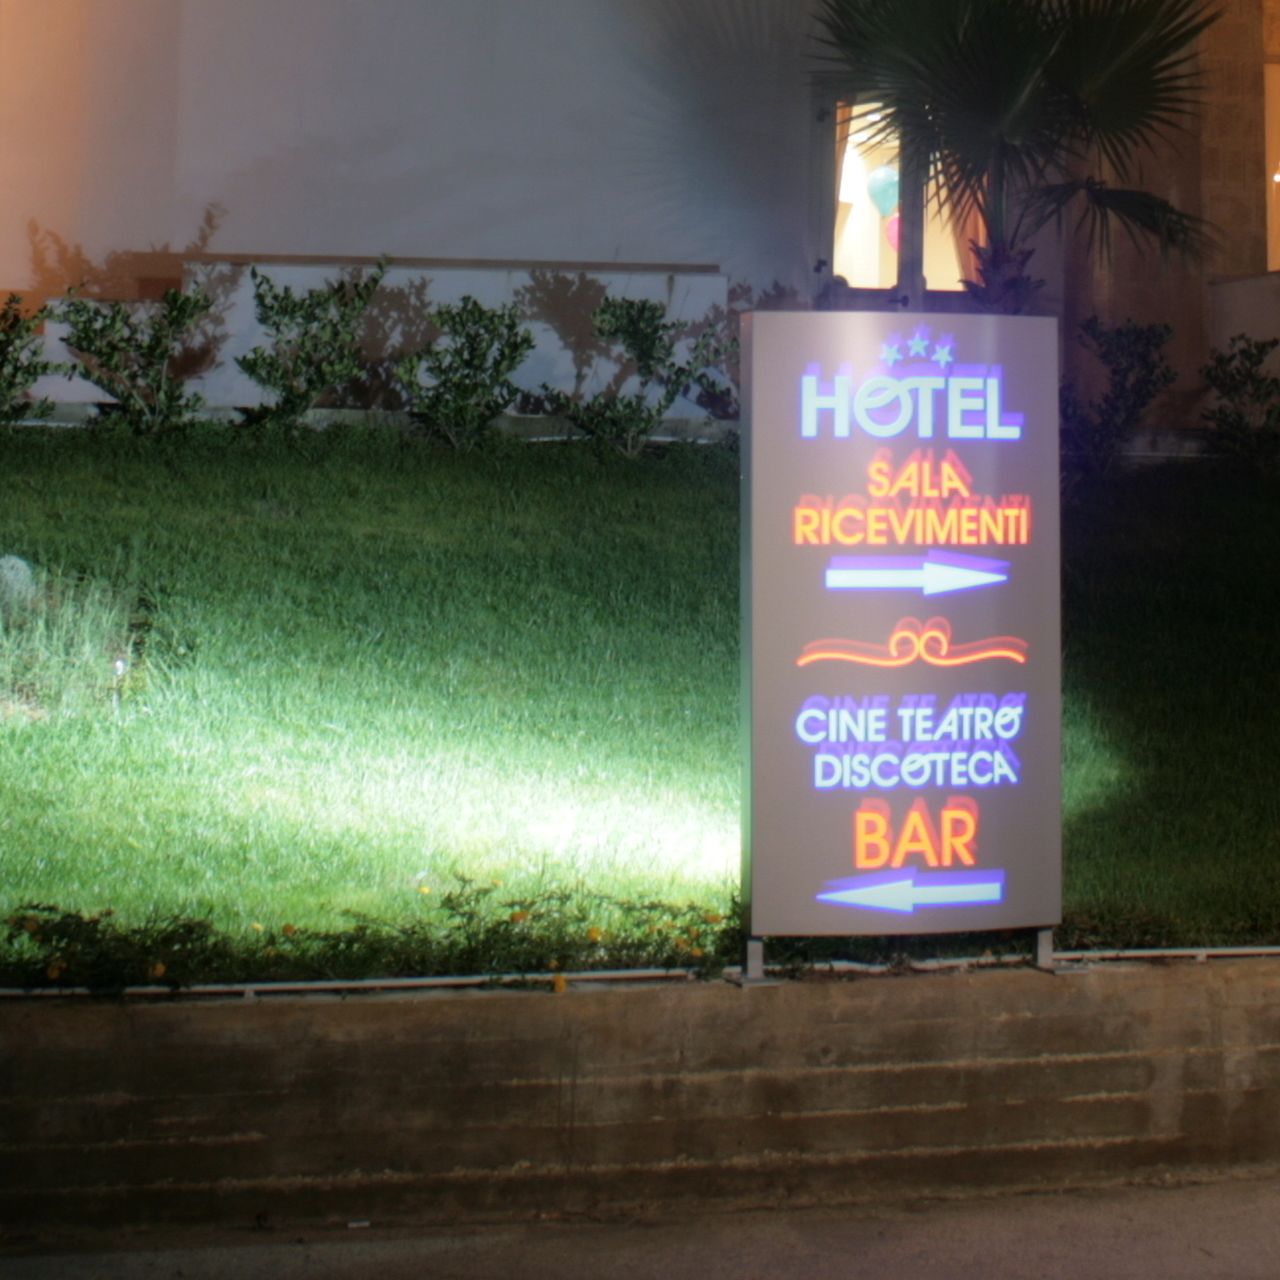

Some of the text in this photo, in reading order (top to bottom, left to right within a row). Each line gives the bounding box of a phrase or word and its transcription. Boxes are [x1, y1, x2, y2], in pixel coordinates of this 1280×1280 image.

[800, 373, 1022, 439] HOTEL
[867, 460, 970, 498] SALA
[792, 505, 1028, 546] RICEVIMENTI
[794, 705, 1025, 743] CINE TEATRO
[813, 751, 1018, 789] DISCOTECA
[854, 809, 977, 869] BAR
